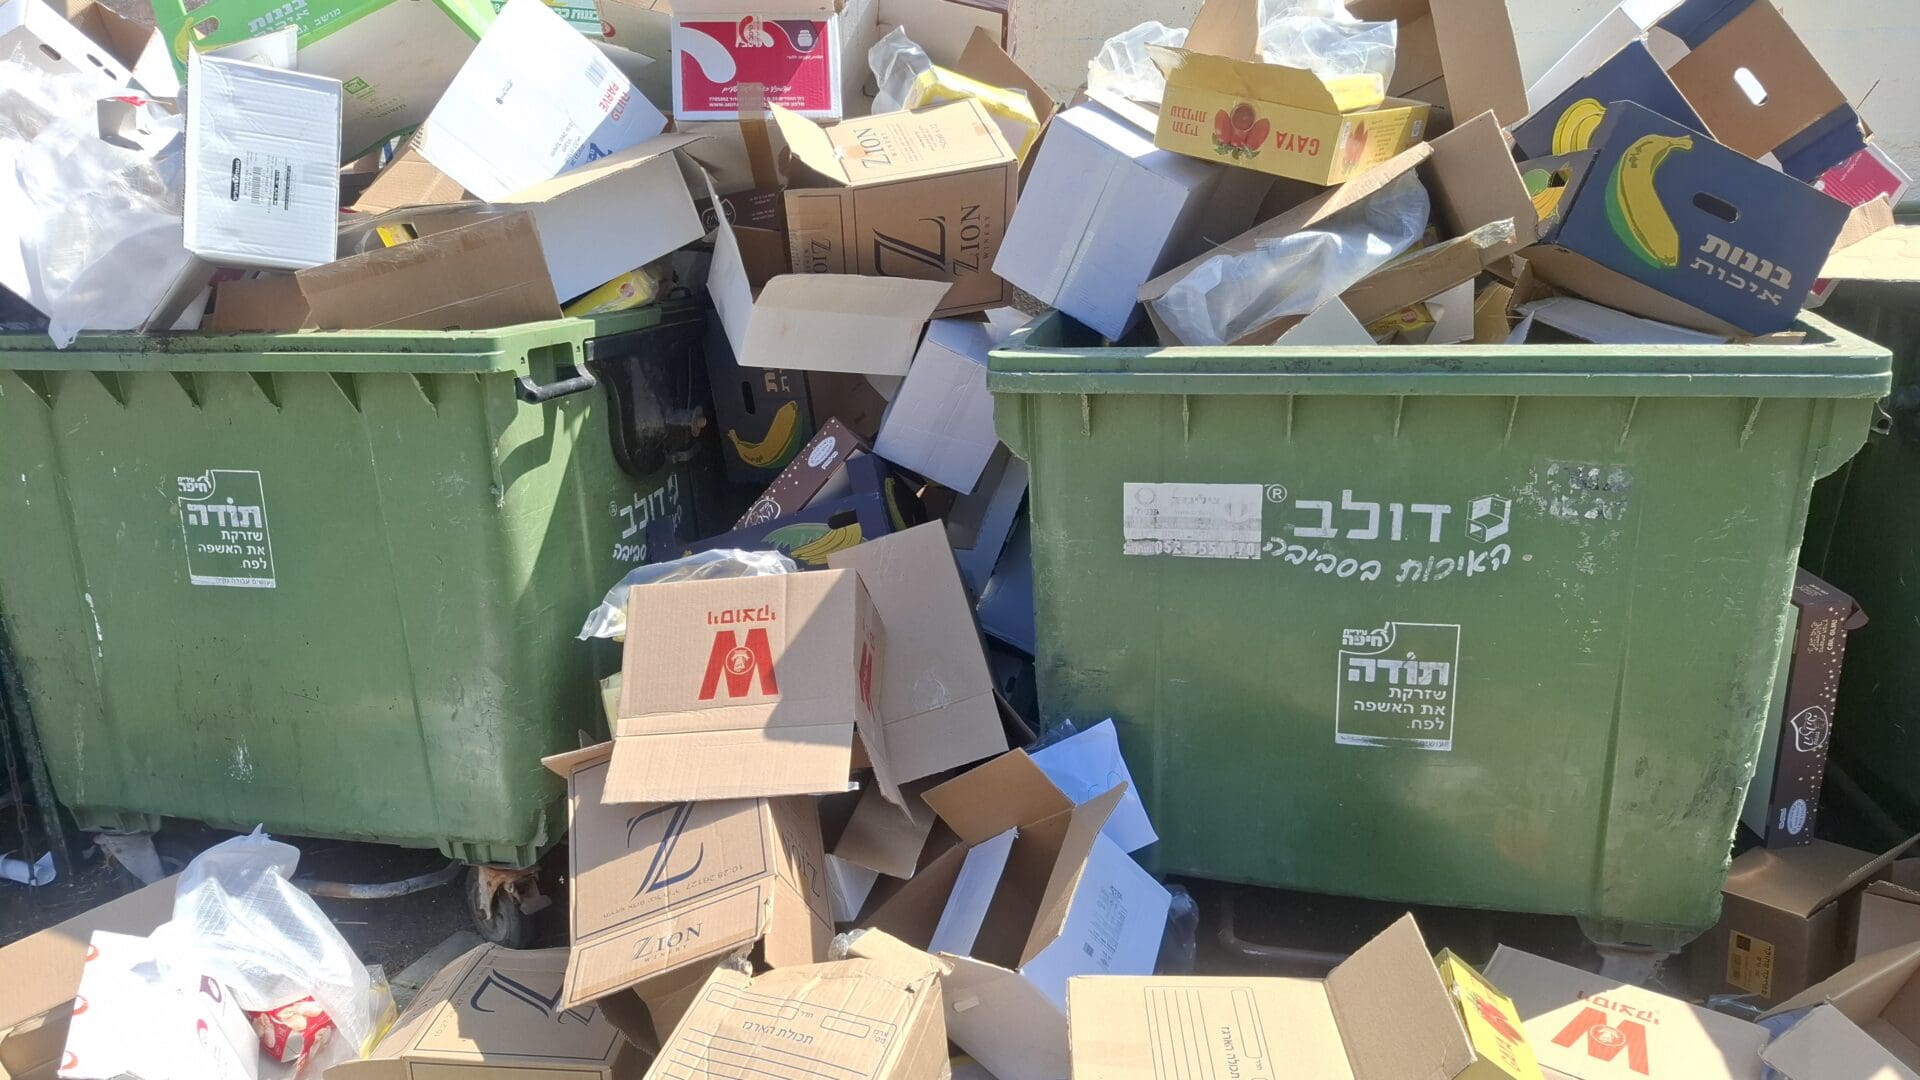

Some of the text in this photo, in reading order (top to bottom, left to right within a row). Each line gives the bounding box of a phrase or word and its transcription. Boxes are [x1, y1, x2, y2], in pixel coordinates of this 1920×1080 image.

[599, 80, 619, 112] PARVE
[853, 128, 891, 168] ZION
[1276, 131, 1321, 157] GAYA
[811, 238, 832, 274] ZIO
[952, 204, 981, 277] ZION
[1699, 233, 1792, 290] בננות
[1690, 257, 1782, 306] איכות
[178, 482, 208, 492] חיפה
[620, 487, 664, 539] דולב
[1294, 489, 1451, 542] דולב
[198, 544, 265, 555] את האשפה
[221, 530, 262, 543] שזרקת
[240, 558, 267, 569] לפח.
[1262, 536, 1511, 582] האיכות בסביבה
[707, 604, 776, 625] ויסוצקי
[1342, 635, 1383, 647] חיפה
[1354, 700, 1445, 715] את האשפה
[1388, 687, 1446, 701] שזרקת
[1406, 717, 1444, 730] לפח.
[633, 923, 703, 961] ZION
[1576, 990, 1660, 1025] ויסוצקי
[742, 1019, 814, 1045] תכולת הארגז
[1221, 1026, 1240, 1079] תכולת הארגז
